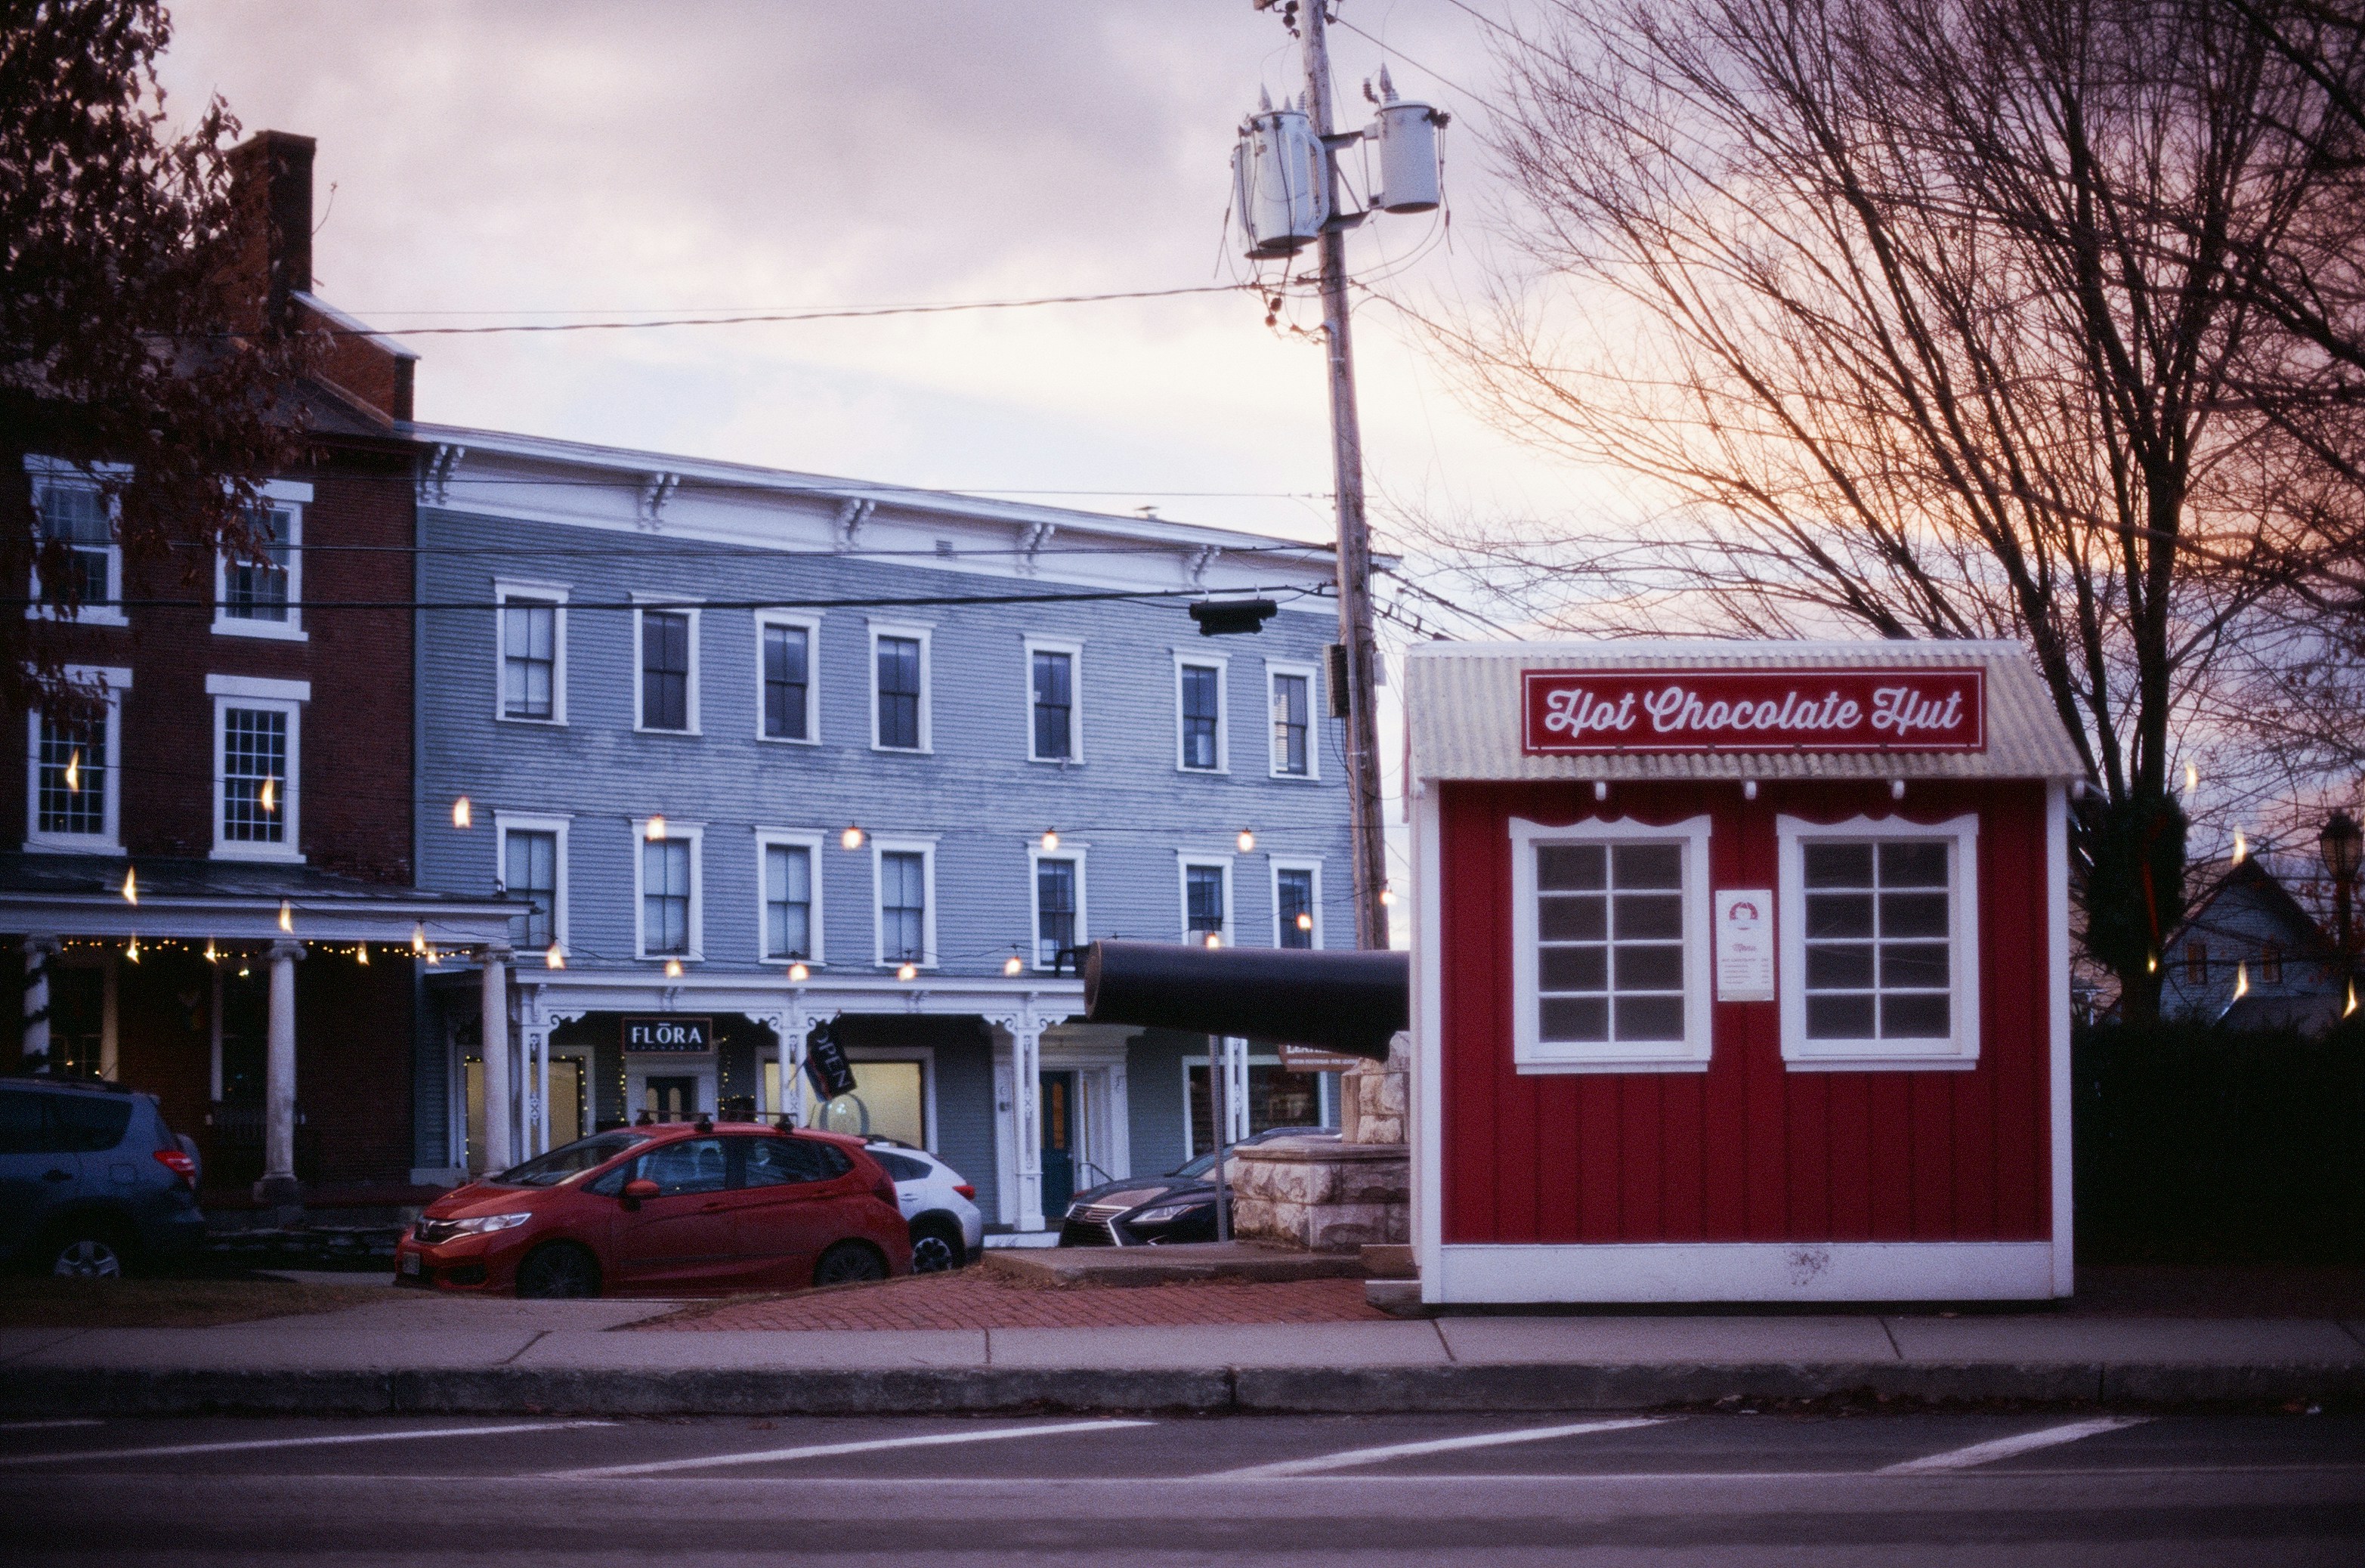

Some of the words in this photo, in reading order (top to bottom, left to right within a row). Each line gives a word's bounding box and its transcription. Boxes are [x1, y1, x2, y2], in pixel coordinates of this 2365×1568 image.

[1544, 688, 1636, 738] Hot
[1644, 686, 1863, 732] Chocolate
[1872, 687, 1962, 735] Hut
